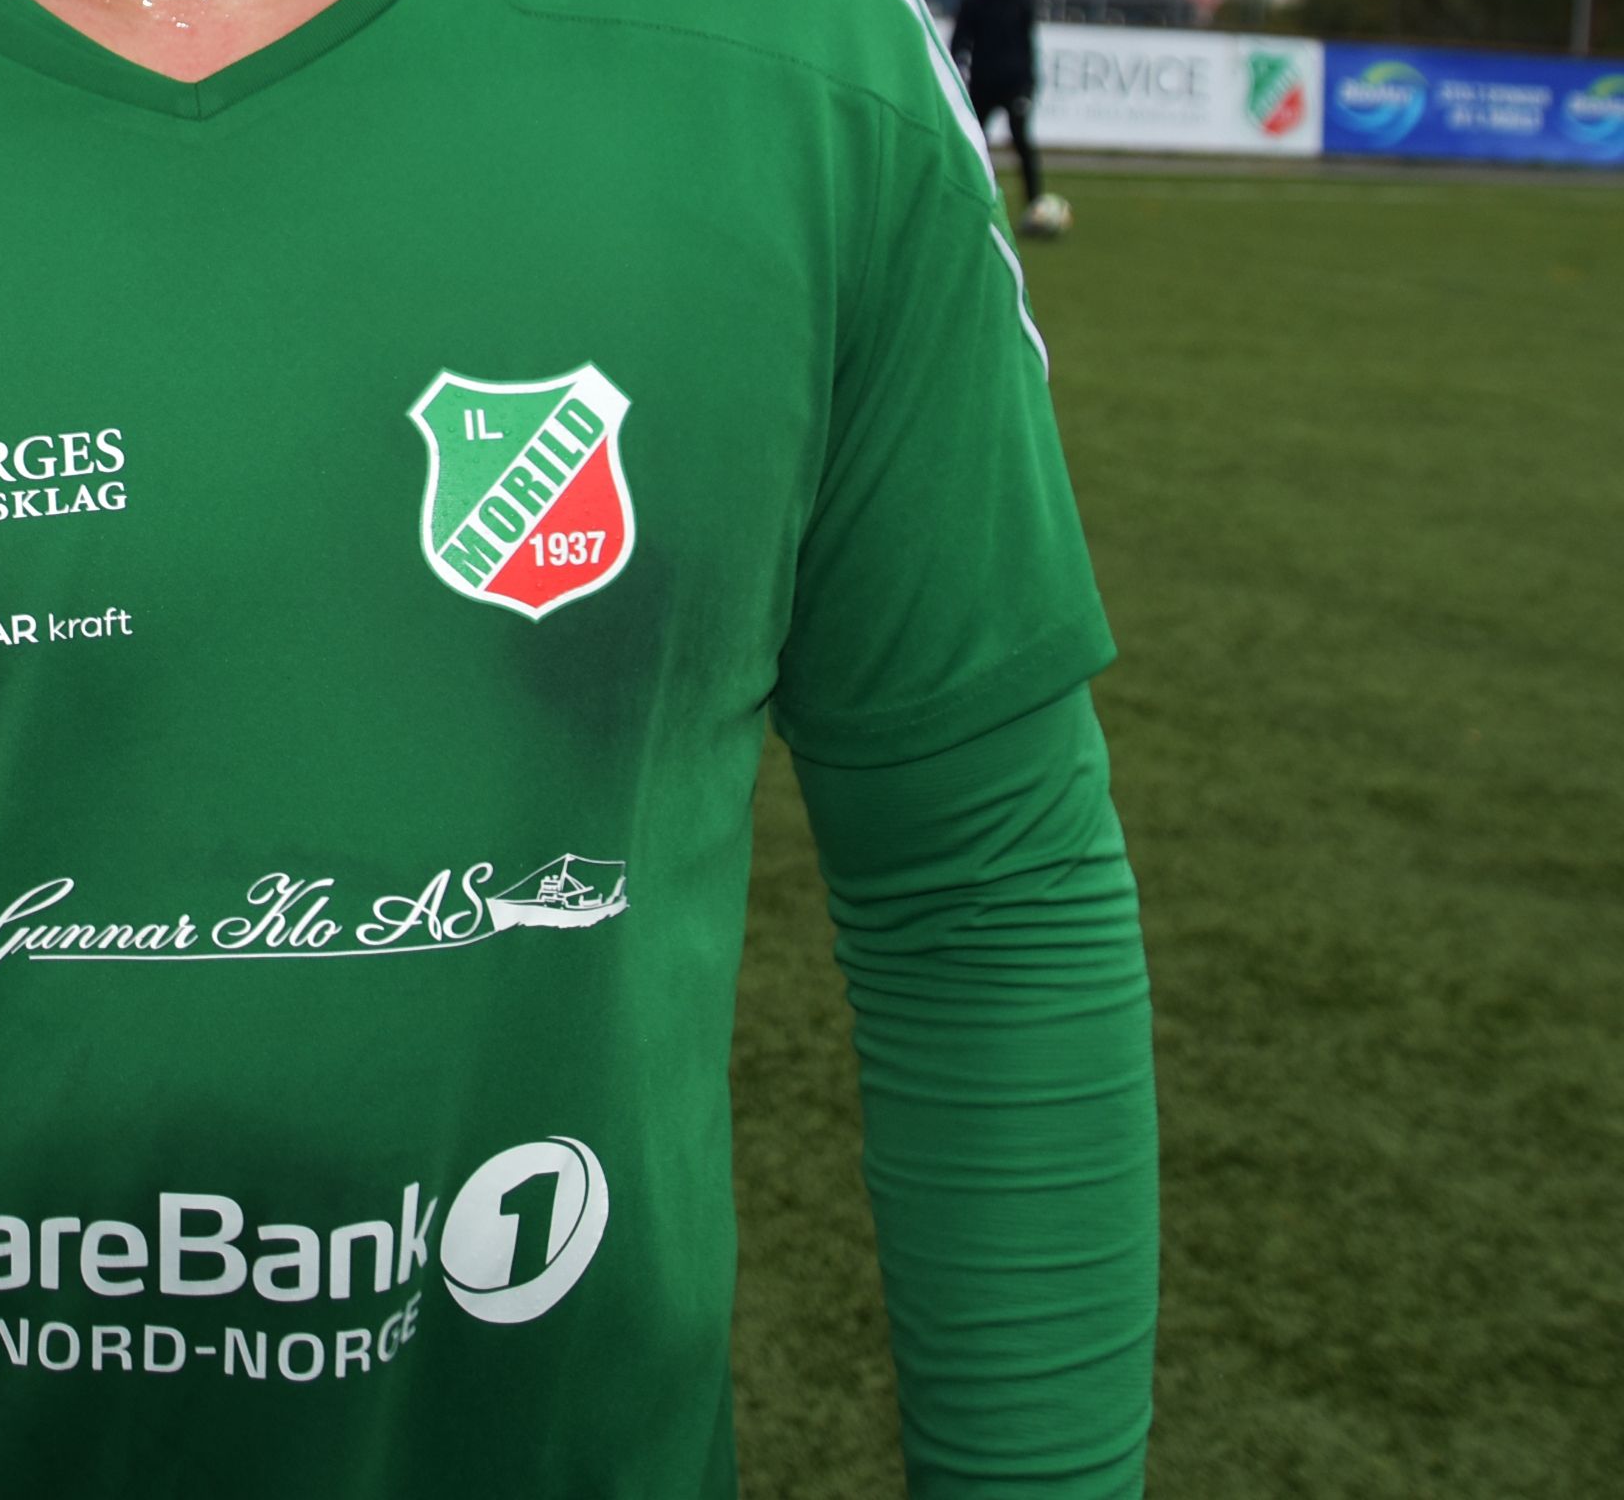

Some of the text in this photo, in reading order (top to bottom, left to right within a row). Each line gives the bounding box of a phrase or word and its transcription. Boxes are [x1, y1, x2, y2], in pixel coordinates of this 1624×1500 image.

[1041, 49, 1212, 98] ERVICE
[464, 408, 504, 441] IL
[440, 397, 606, 589] MORILD
[528, 530, 606, 567] 1937
[48, 607, 134, 642] kraft
[211, 872, 339, 950] Klo
[354, 861, 494, 950] AS
